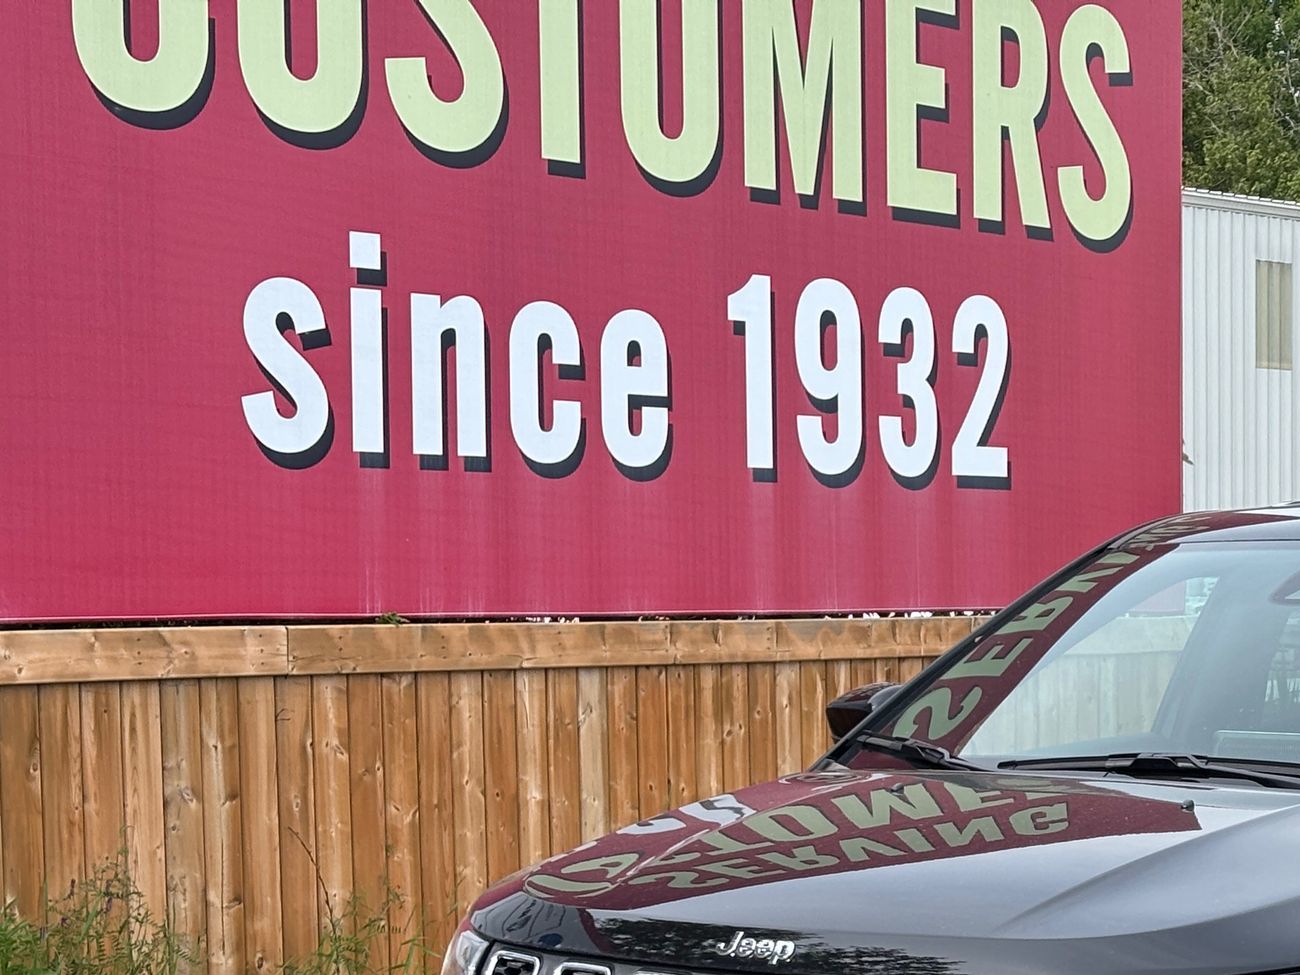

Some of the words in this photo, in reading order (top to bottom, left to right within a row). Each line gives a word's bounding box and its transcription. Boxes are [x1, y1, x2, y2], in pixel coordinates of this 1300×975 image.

[241, 231, 672, 480] since
[727, 274, 1010, 488] 1932
[716, 930, 796, 965] Jeep
